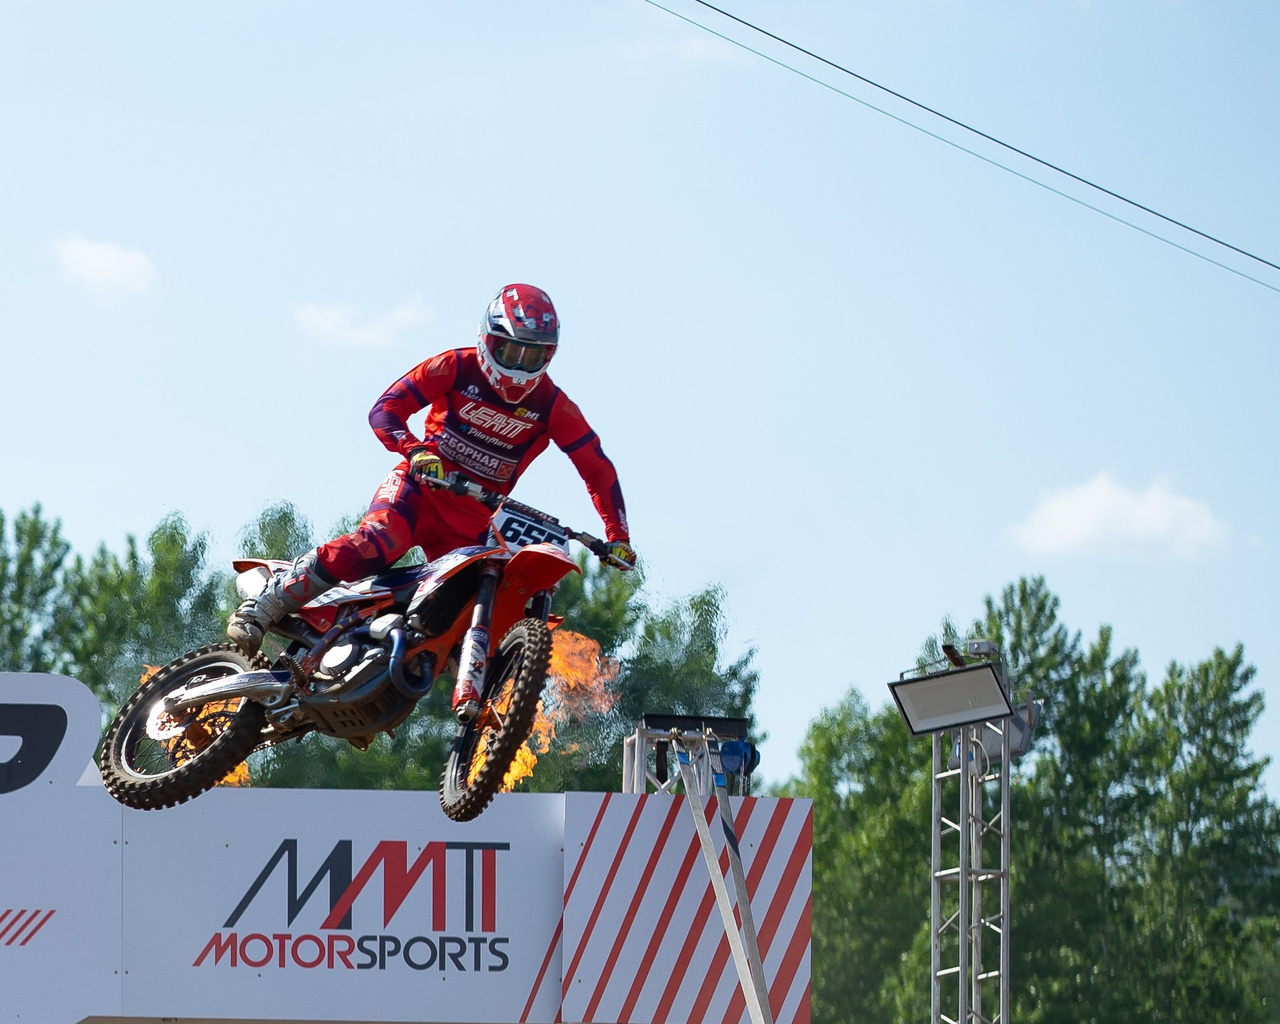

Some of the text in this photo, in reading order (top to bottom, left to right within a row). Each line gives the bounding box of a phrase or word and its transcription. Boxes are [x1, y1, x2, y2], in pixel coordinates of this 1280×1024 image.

[459, 401, 533, 438] LEATT
[441, 432, 500, 469] СБОРНАЯ
[222, 838, 511, 932] MMT
[192, 932, 510, 972] MOTORSPORTS
